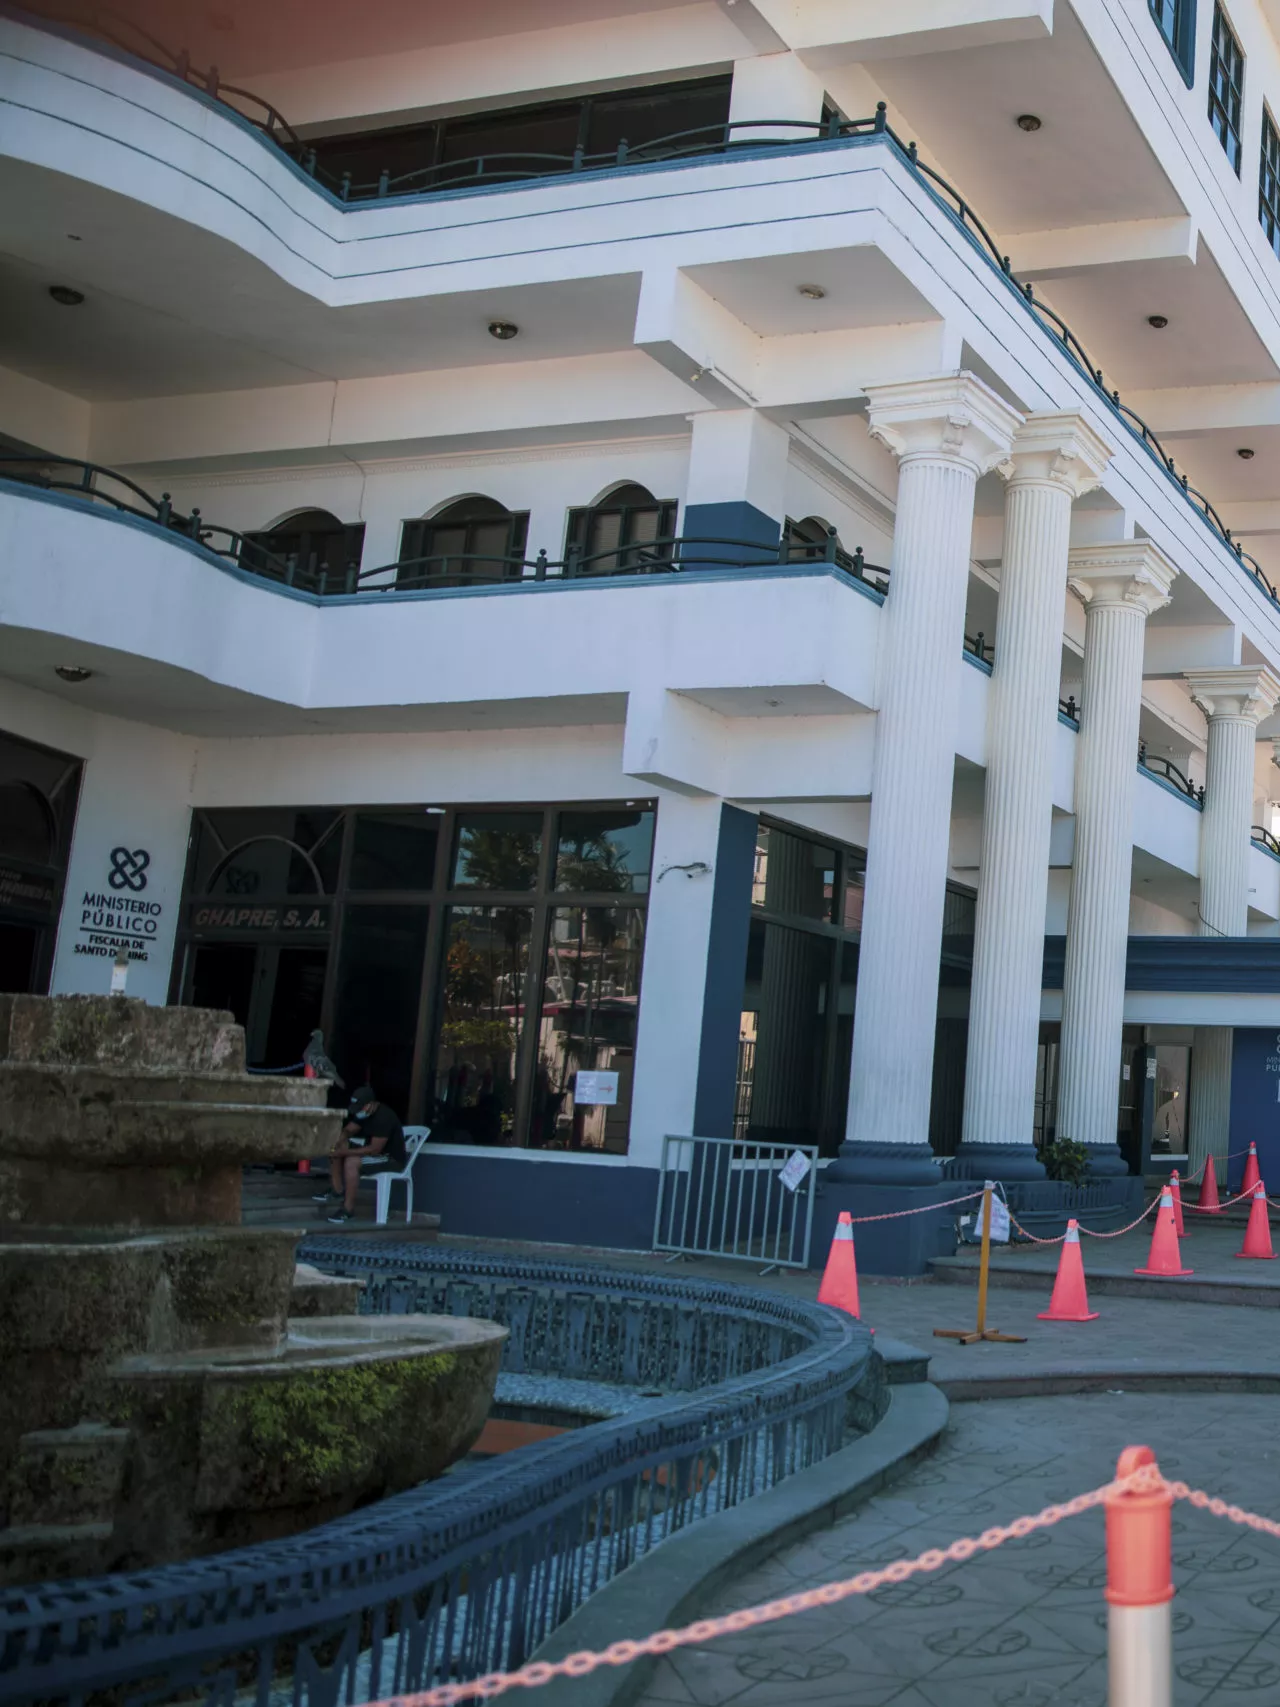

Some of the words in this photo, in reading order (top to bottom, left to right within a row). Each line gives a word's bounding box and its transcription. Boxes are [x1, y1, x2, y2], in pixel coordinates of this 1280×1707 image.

[82, 891, 162, 916] MINISTERIO
[81, 909, 157, 933] PÚBLICO
[74, 943, 107, 957] SANTO
[132, 940, 145, 950] DE
